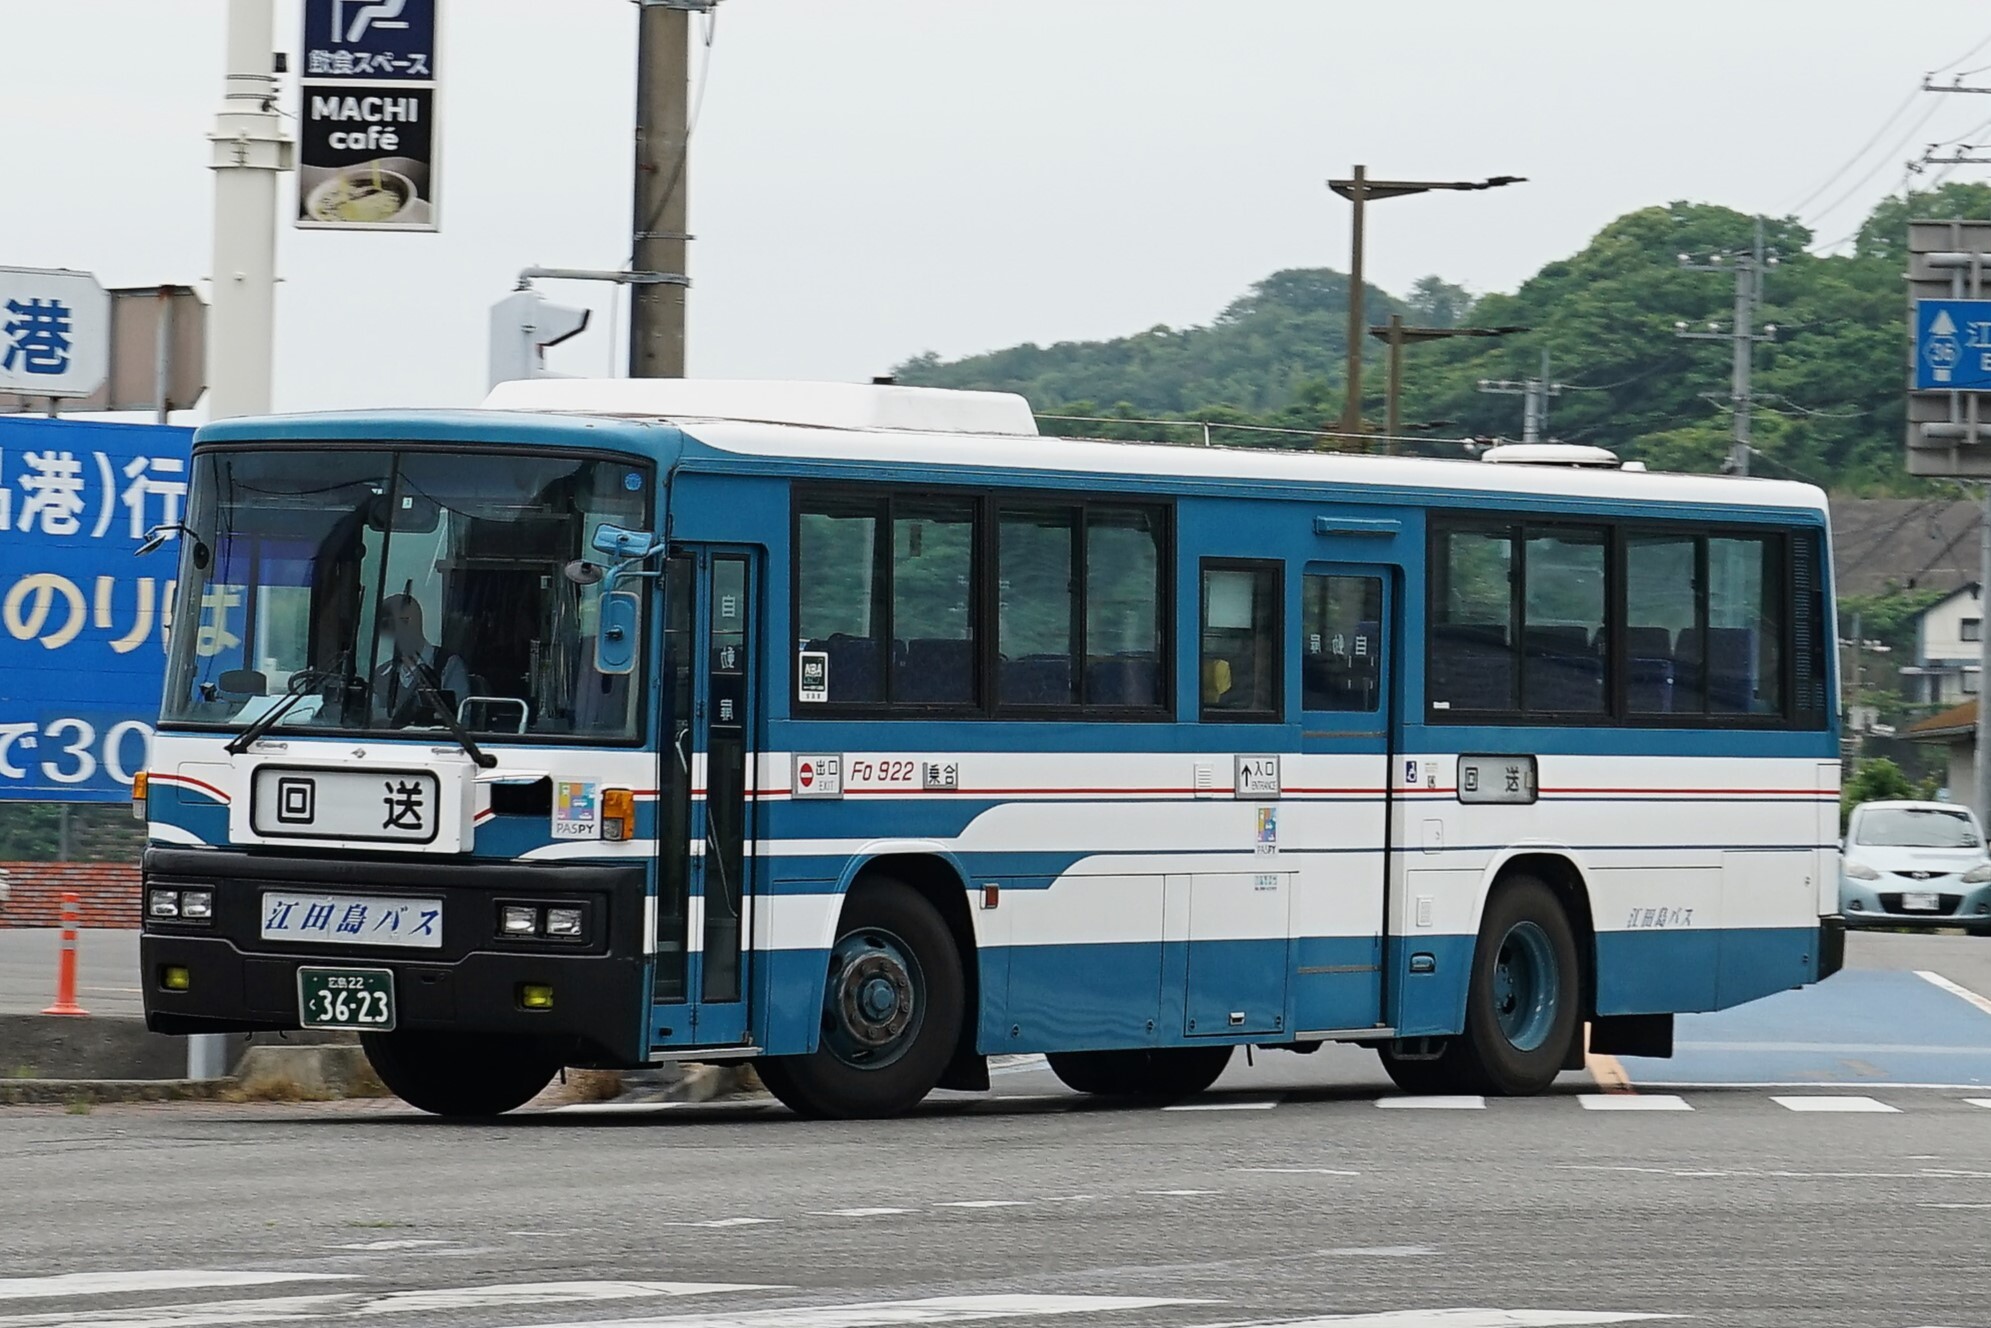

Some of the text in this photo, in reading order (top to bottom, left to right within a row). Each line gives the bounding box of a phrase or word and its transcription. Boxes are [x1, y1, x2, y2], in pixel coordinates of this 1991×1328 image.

[308, 49, 430, 75] 飲食スペース
[311, 96, 418, 122] MACHI
[328, 125, 399, 150] café
[1, 298, 72, 375] 港
[0, 446, 188, 540] 港)行
[816, 760, 837, 775] 出口
[878, 761, 914, 781] 922
[928, 764, 955, 785] 乗合
[1254, 761, 1274, 776] 入口
[819, 780, 835, 791] EXIT
[277, 777, 423, 831] 回送
[556, 823, 595, 835] PASPY
[265, 901, 440, 936] 江田島バス
[318, 989, 388, 1023] 36-23
